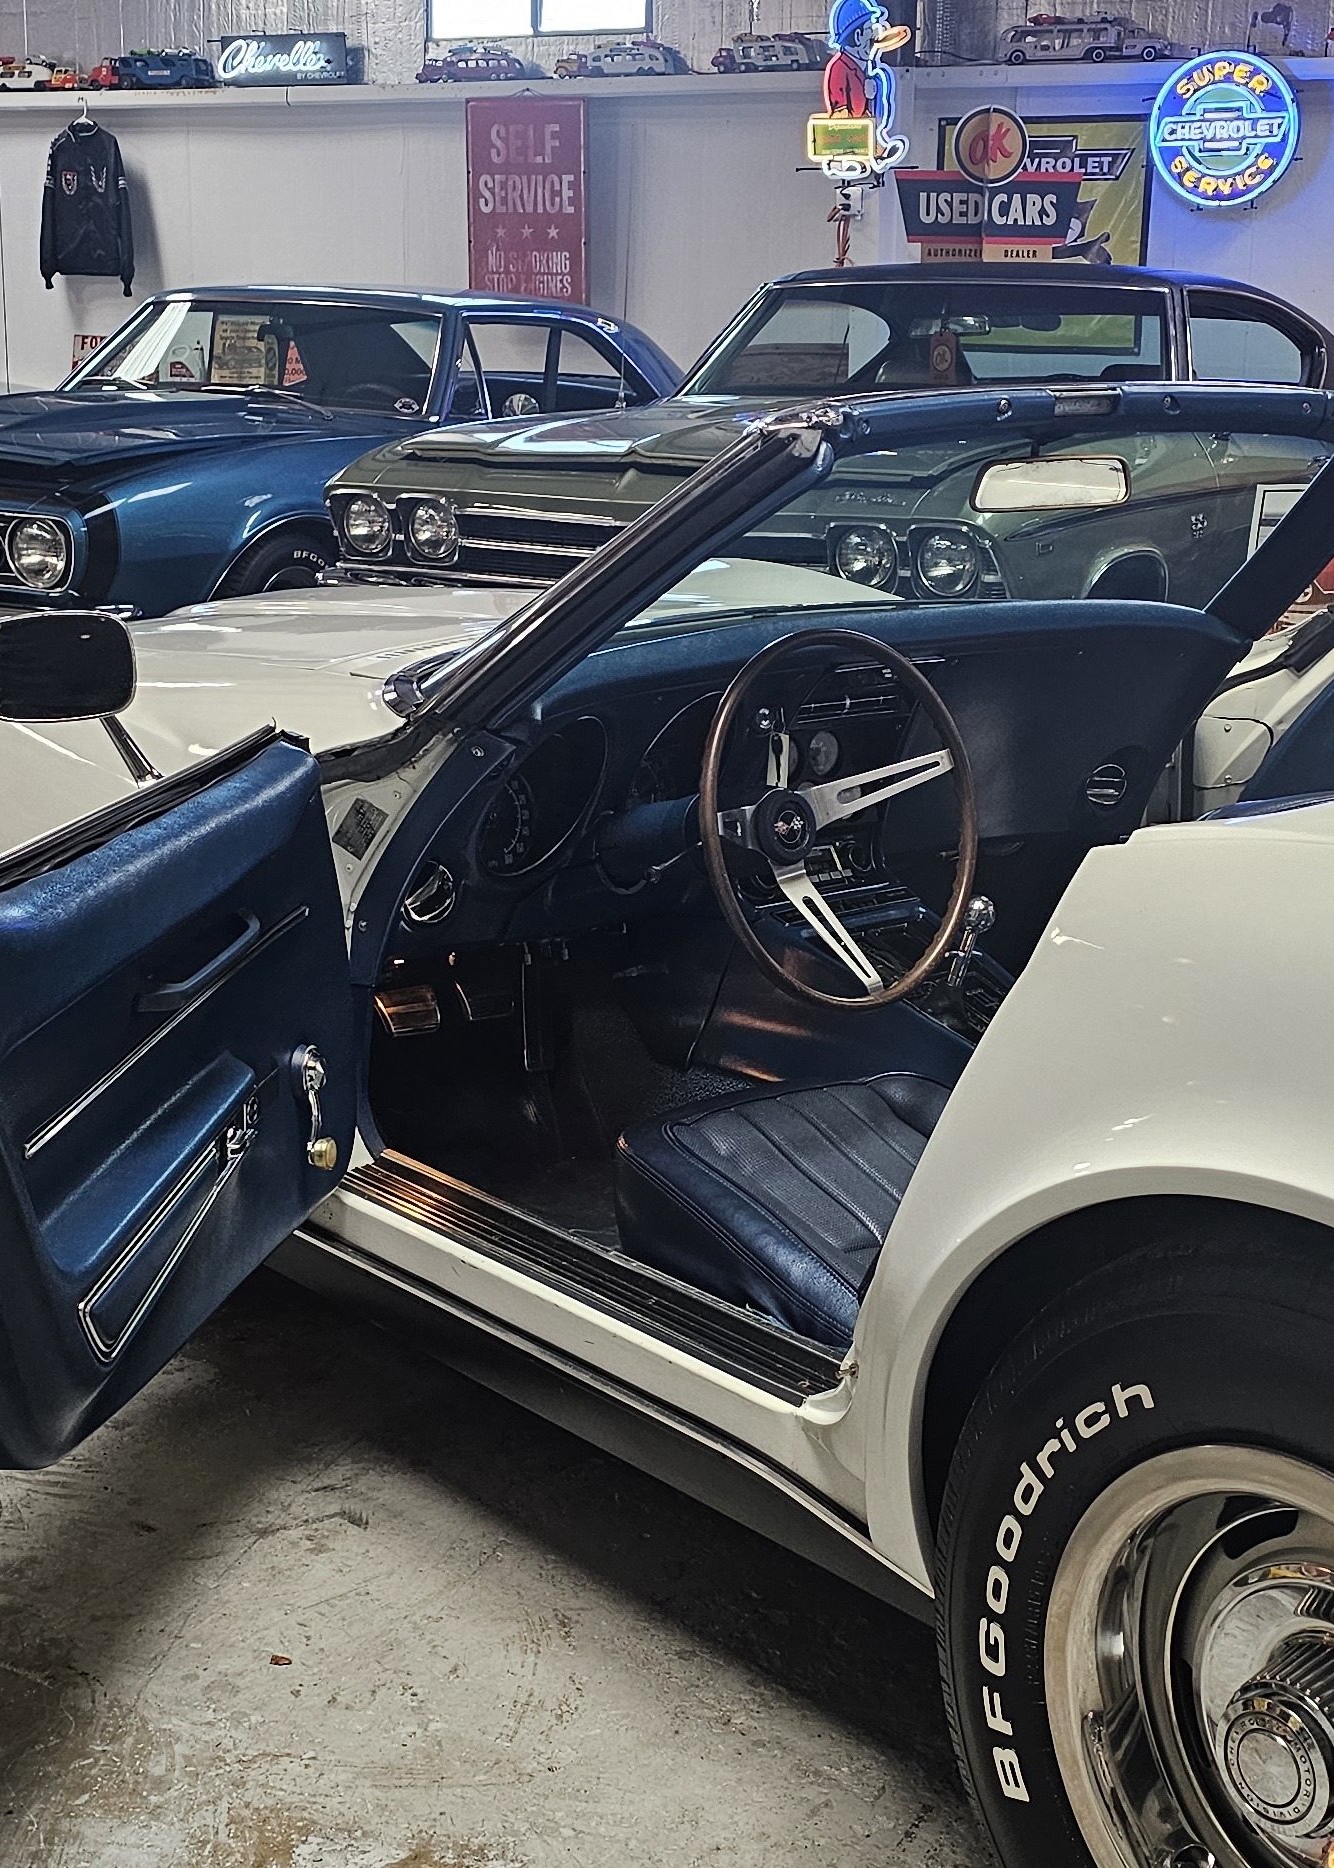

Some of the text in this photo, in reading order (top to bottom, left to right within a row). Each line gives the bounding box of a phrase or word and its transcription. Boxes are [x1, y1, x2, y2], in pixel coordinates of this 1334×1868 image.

[218, 39, 328, 79] Chevelle
[307, 71, 346, 80] CHEVROLET
[1176, 61, 1273, 98] SUPER
[490, 123, 560, 164] SELF
[969, 121, 1015, 166] OK
[1163, 118, 1285, 141] CHEVROLET
[1025, 157, 1113, 173] VROLET
[1171, 152, 1276, 196] SERVICE
[479, 174, 575, 214] SERVICE
[919, 192, 1057, 226] USED CARS
[488, 249, 504, 273] NO
[1004, 249, 1038, 258] DEALER
